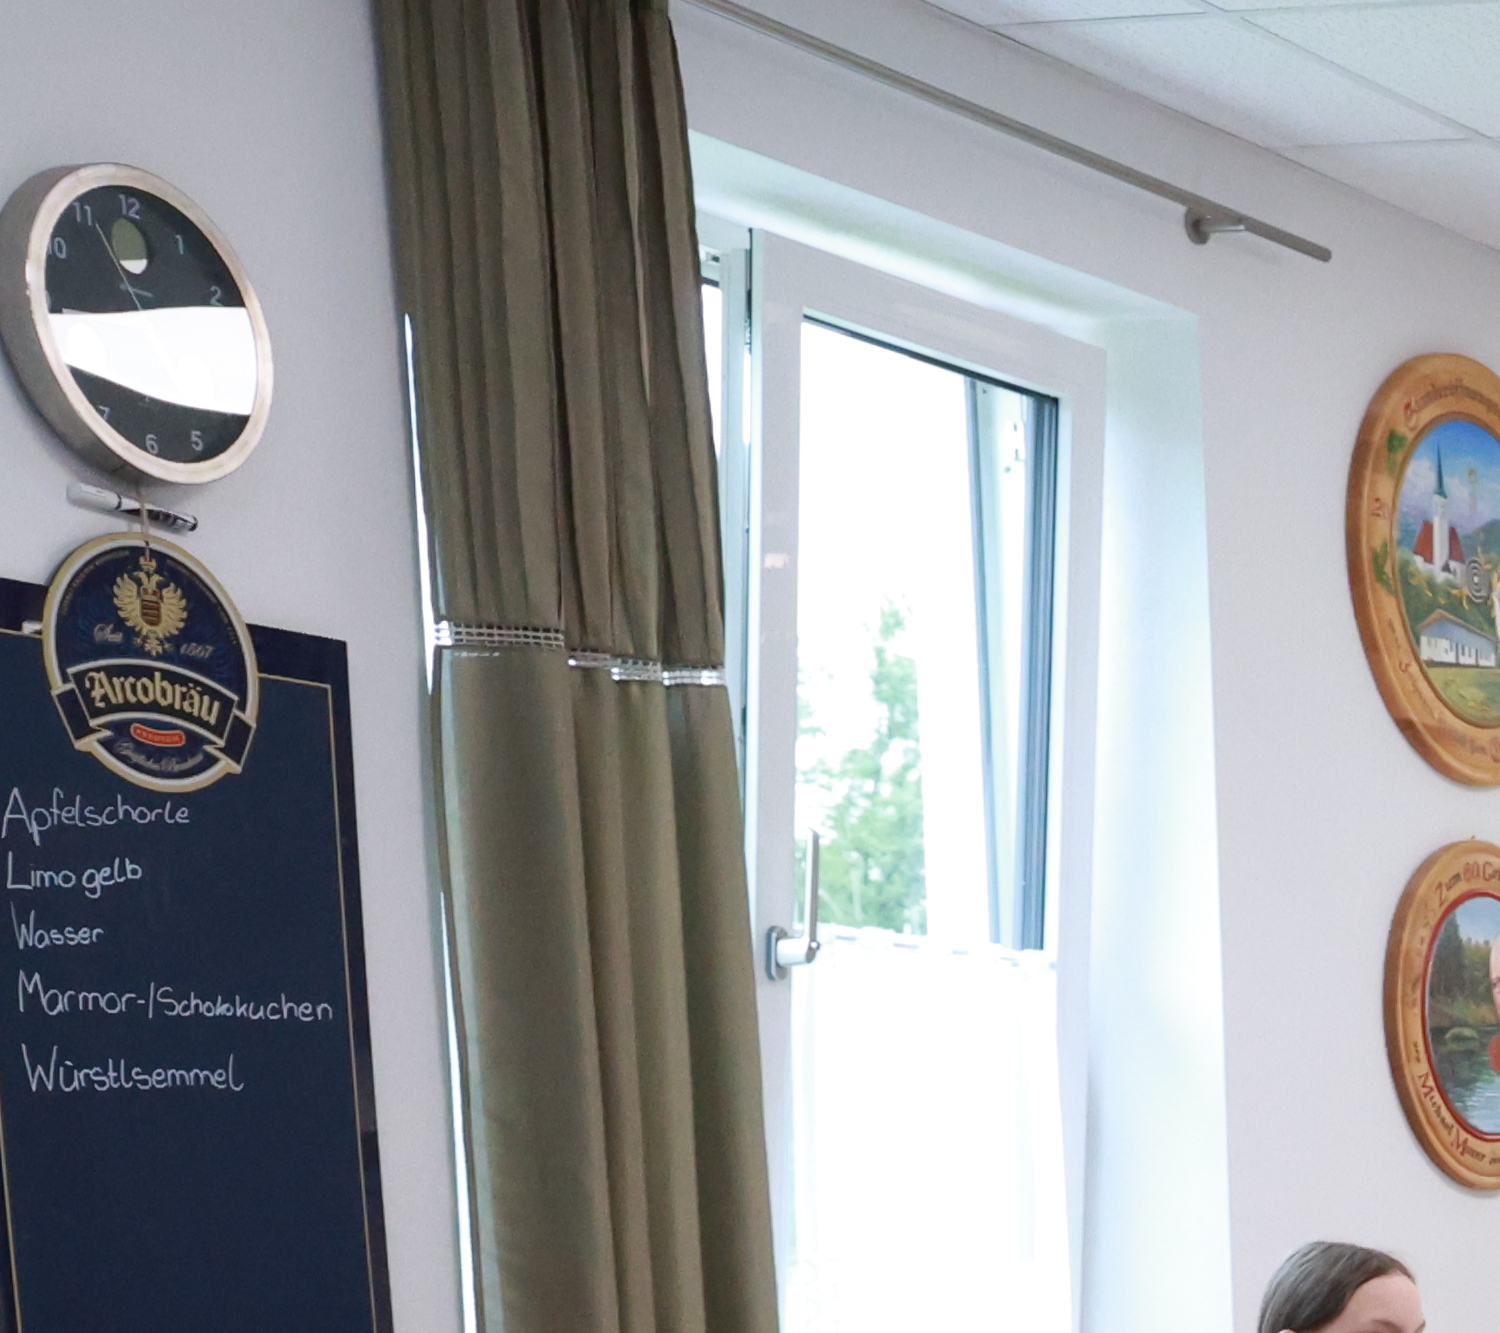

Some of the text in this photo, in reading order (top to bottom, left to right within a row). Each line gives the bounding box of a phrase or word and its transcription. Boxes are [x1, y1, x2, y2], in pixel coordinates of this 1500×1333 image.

[119, 194, 140, 219] 12
[145, 434, 158, 454] 6
[190, 431, 203, 451] 5
[84, 671, 221, 726] Arcobräu
[1, 787, 191, 846] Apfelschorle
[6, 851, 143, 898] Limo gelb
[11, 901, 104, 950] Wasser
[21, 1043, 244, 1092] Würstlsemmel
